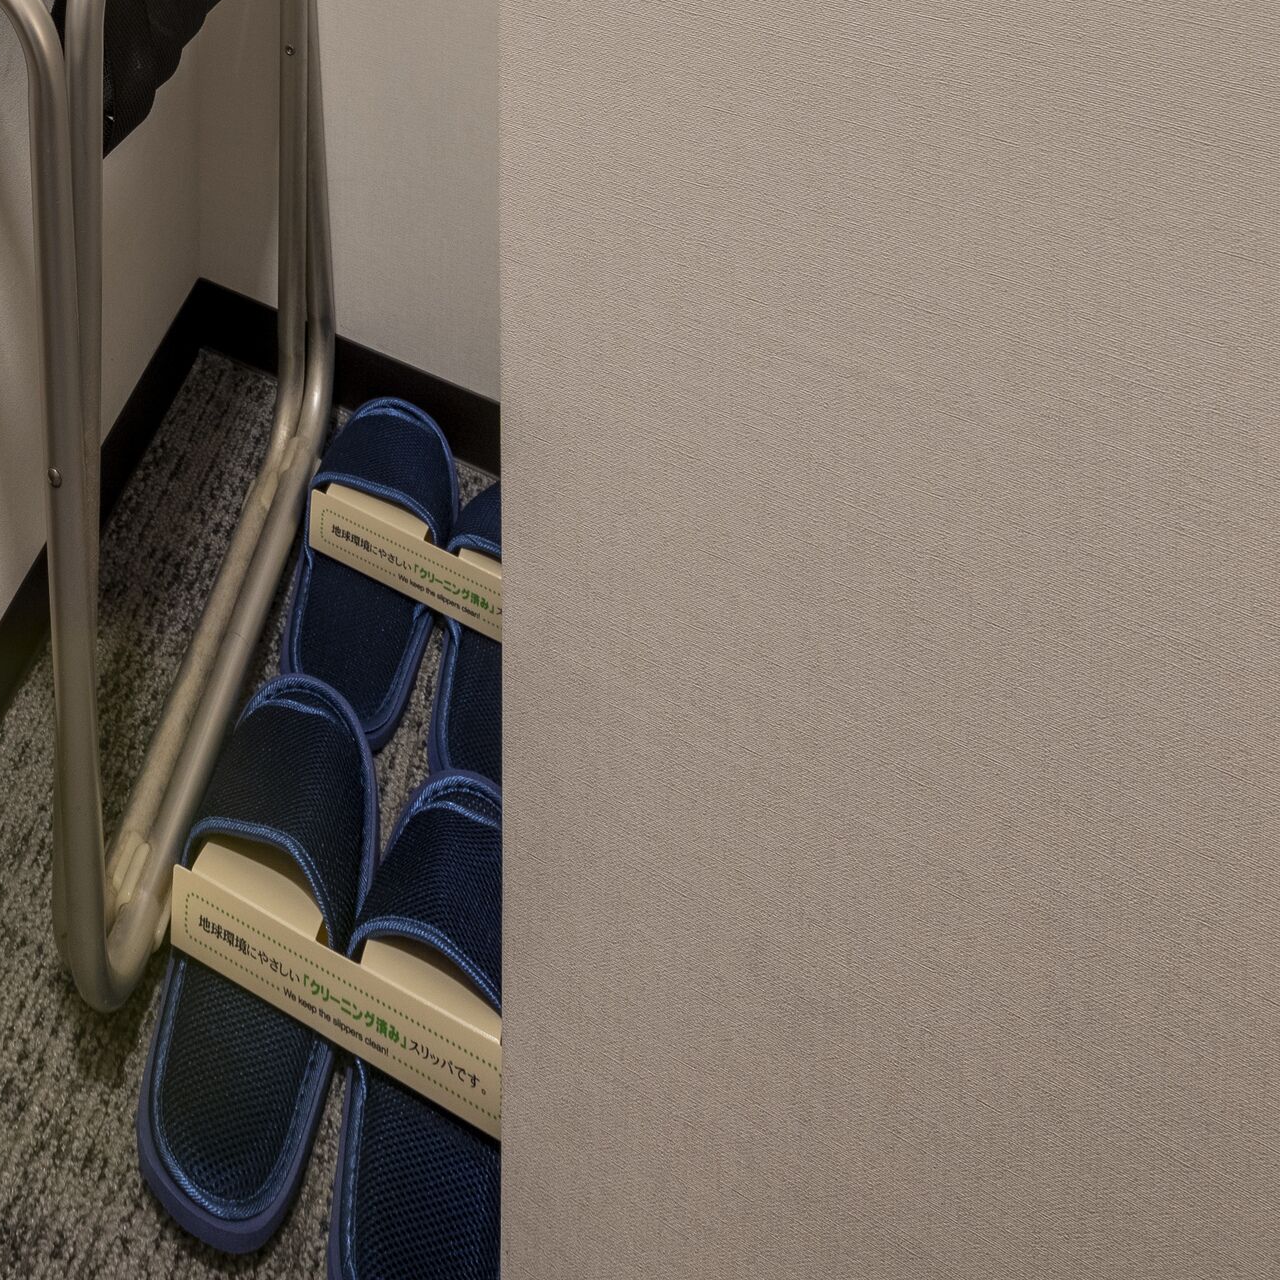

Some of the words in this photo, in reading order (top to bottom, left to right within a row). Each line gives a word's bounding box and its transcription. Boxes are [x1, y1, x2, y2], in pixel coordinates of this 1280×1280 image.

[398, 573, 409, 585] We
[409, 578, 425, 593] keep
[425, 585, 436, 597] the
[436, 591, 461, 610] slippers
[282, 986, 297, 1002] We
[297, 994, 318, 1018] keep
[318, 1006, 331, 1023] the
[332, 1013, 364, 1040] slippers
[364, 1033, 390, 1057] clean!
